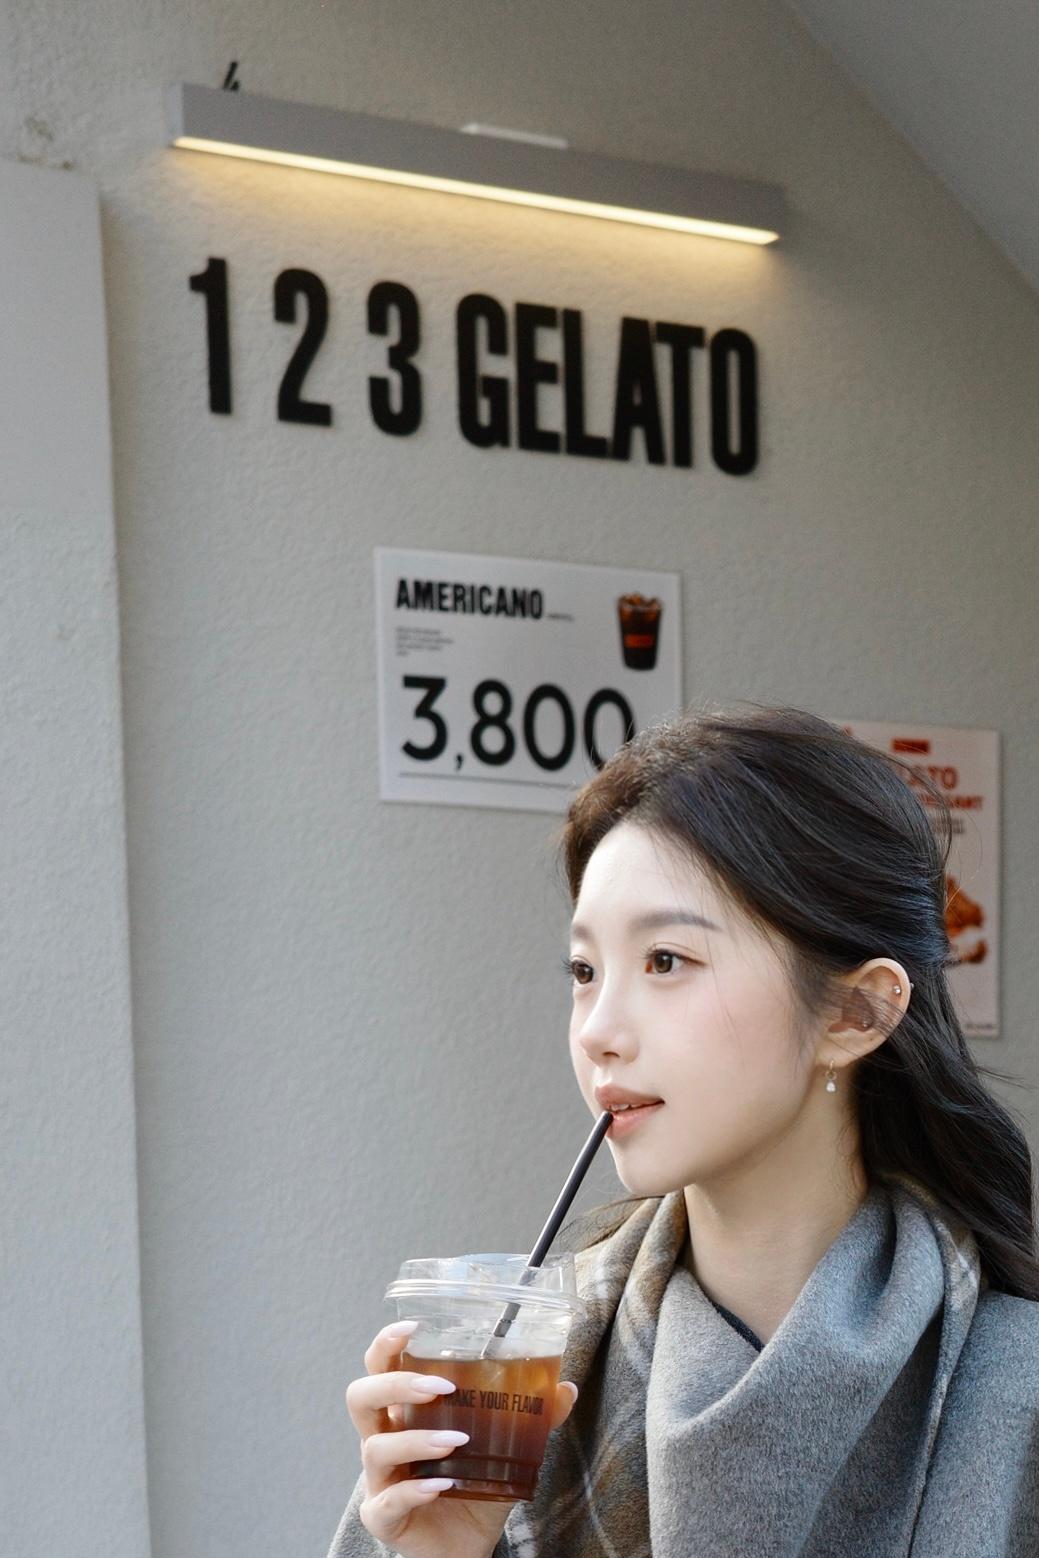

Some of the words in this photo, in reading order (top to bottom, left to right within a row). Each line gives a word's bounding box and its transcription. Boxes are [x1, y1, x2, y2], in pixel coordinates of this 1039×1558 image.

[189, 257, 232, 415] 1
[273, 268, 332, 427] 2
[366, 281, 423, 436] 3
[456, 292, 759, 476] GELATO
[395, 578, 544, 620] AMERICANO
[402, 675, 635, 772] 3,800
[479, 1390, 509, 1411] YOUR
